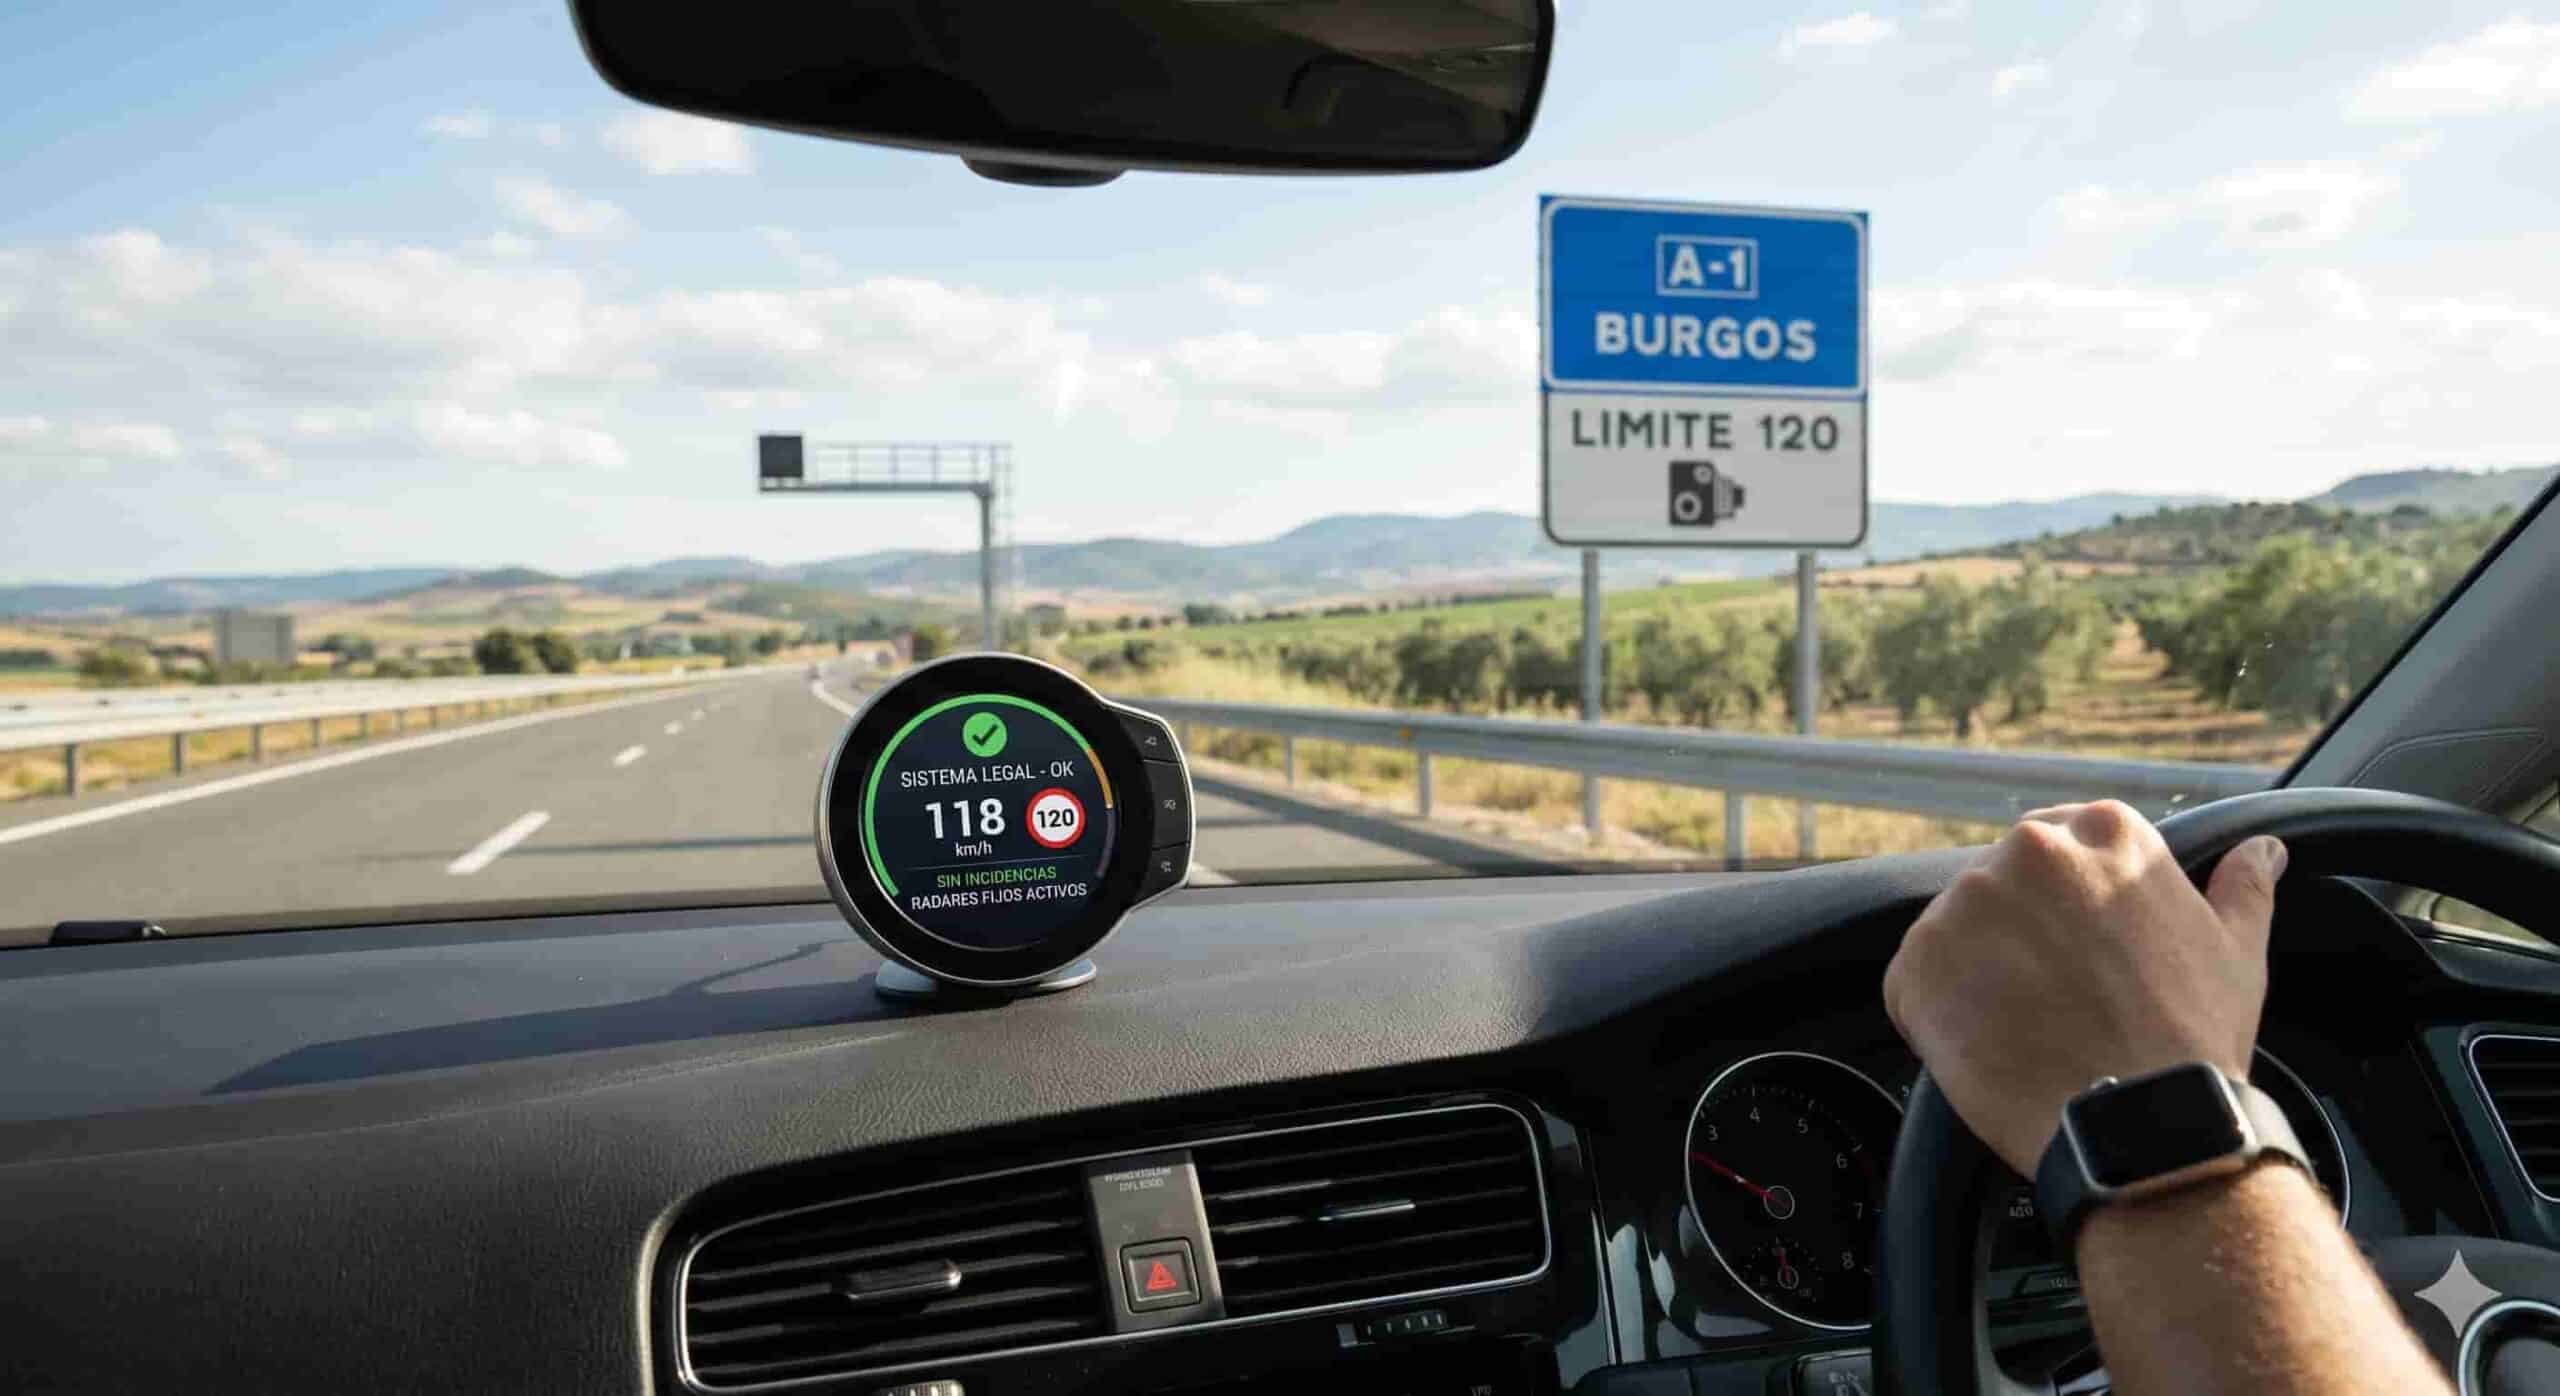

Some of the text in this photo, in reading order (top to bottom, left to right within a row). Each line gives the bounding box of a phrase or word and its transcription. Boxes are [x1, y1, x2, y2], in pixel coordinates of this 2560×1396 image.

[1668, 244, 1747, 289] A-1
[1595, 312, 1817, 361] BURGOS
[1572, 410, 1839, 451] LIMITE 120
[901, 767, 978, 788] SISTEMA
[982, 763, 1036, 782] LEGAL
[1050, 761, 1074, 778] OK
[925, 798, 1006, 839] 118
[1037, 809, 1075, 828] 120
[955, 841, 993, 857] km/h
[937, 866, 1057, 888] SIN INCIDENCIAS
[911, 882, 1088, 910] RADARES FIJOS ACTIVOS
[1750, 1106, 1760, 1122] 4
[1708, 1125, 1718, 1141] 3
[1798, 1118, 1808, 1134] 5
[1836, 1153, 1848, 1169] 6
[1853, 1202, 1863, 1219] 7
[1841, 1251, 1854, 1269] 8
